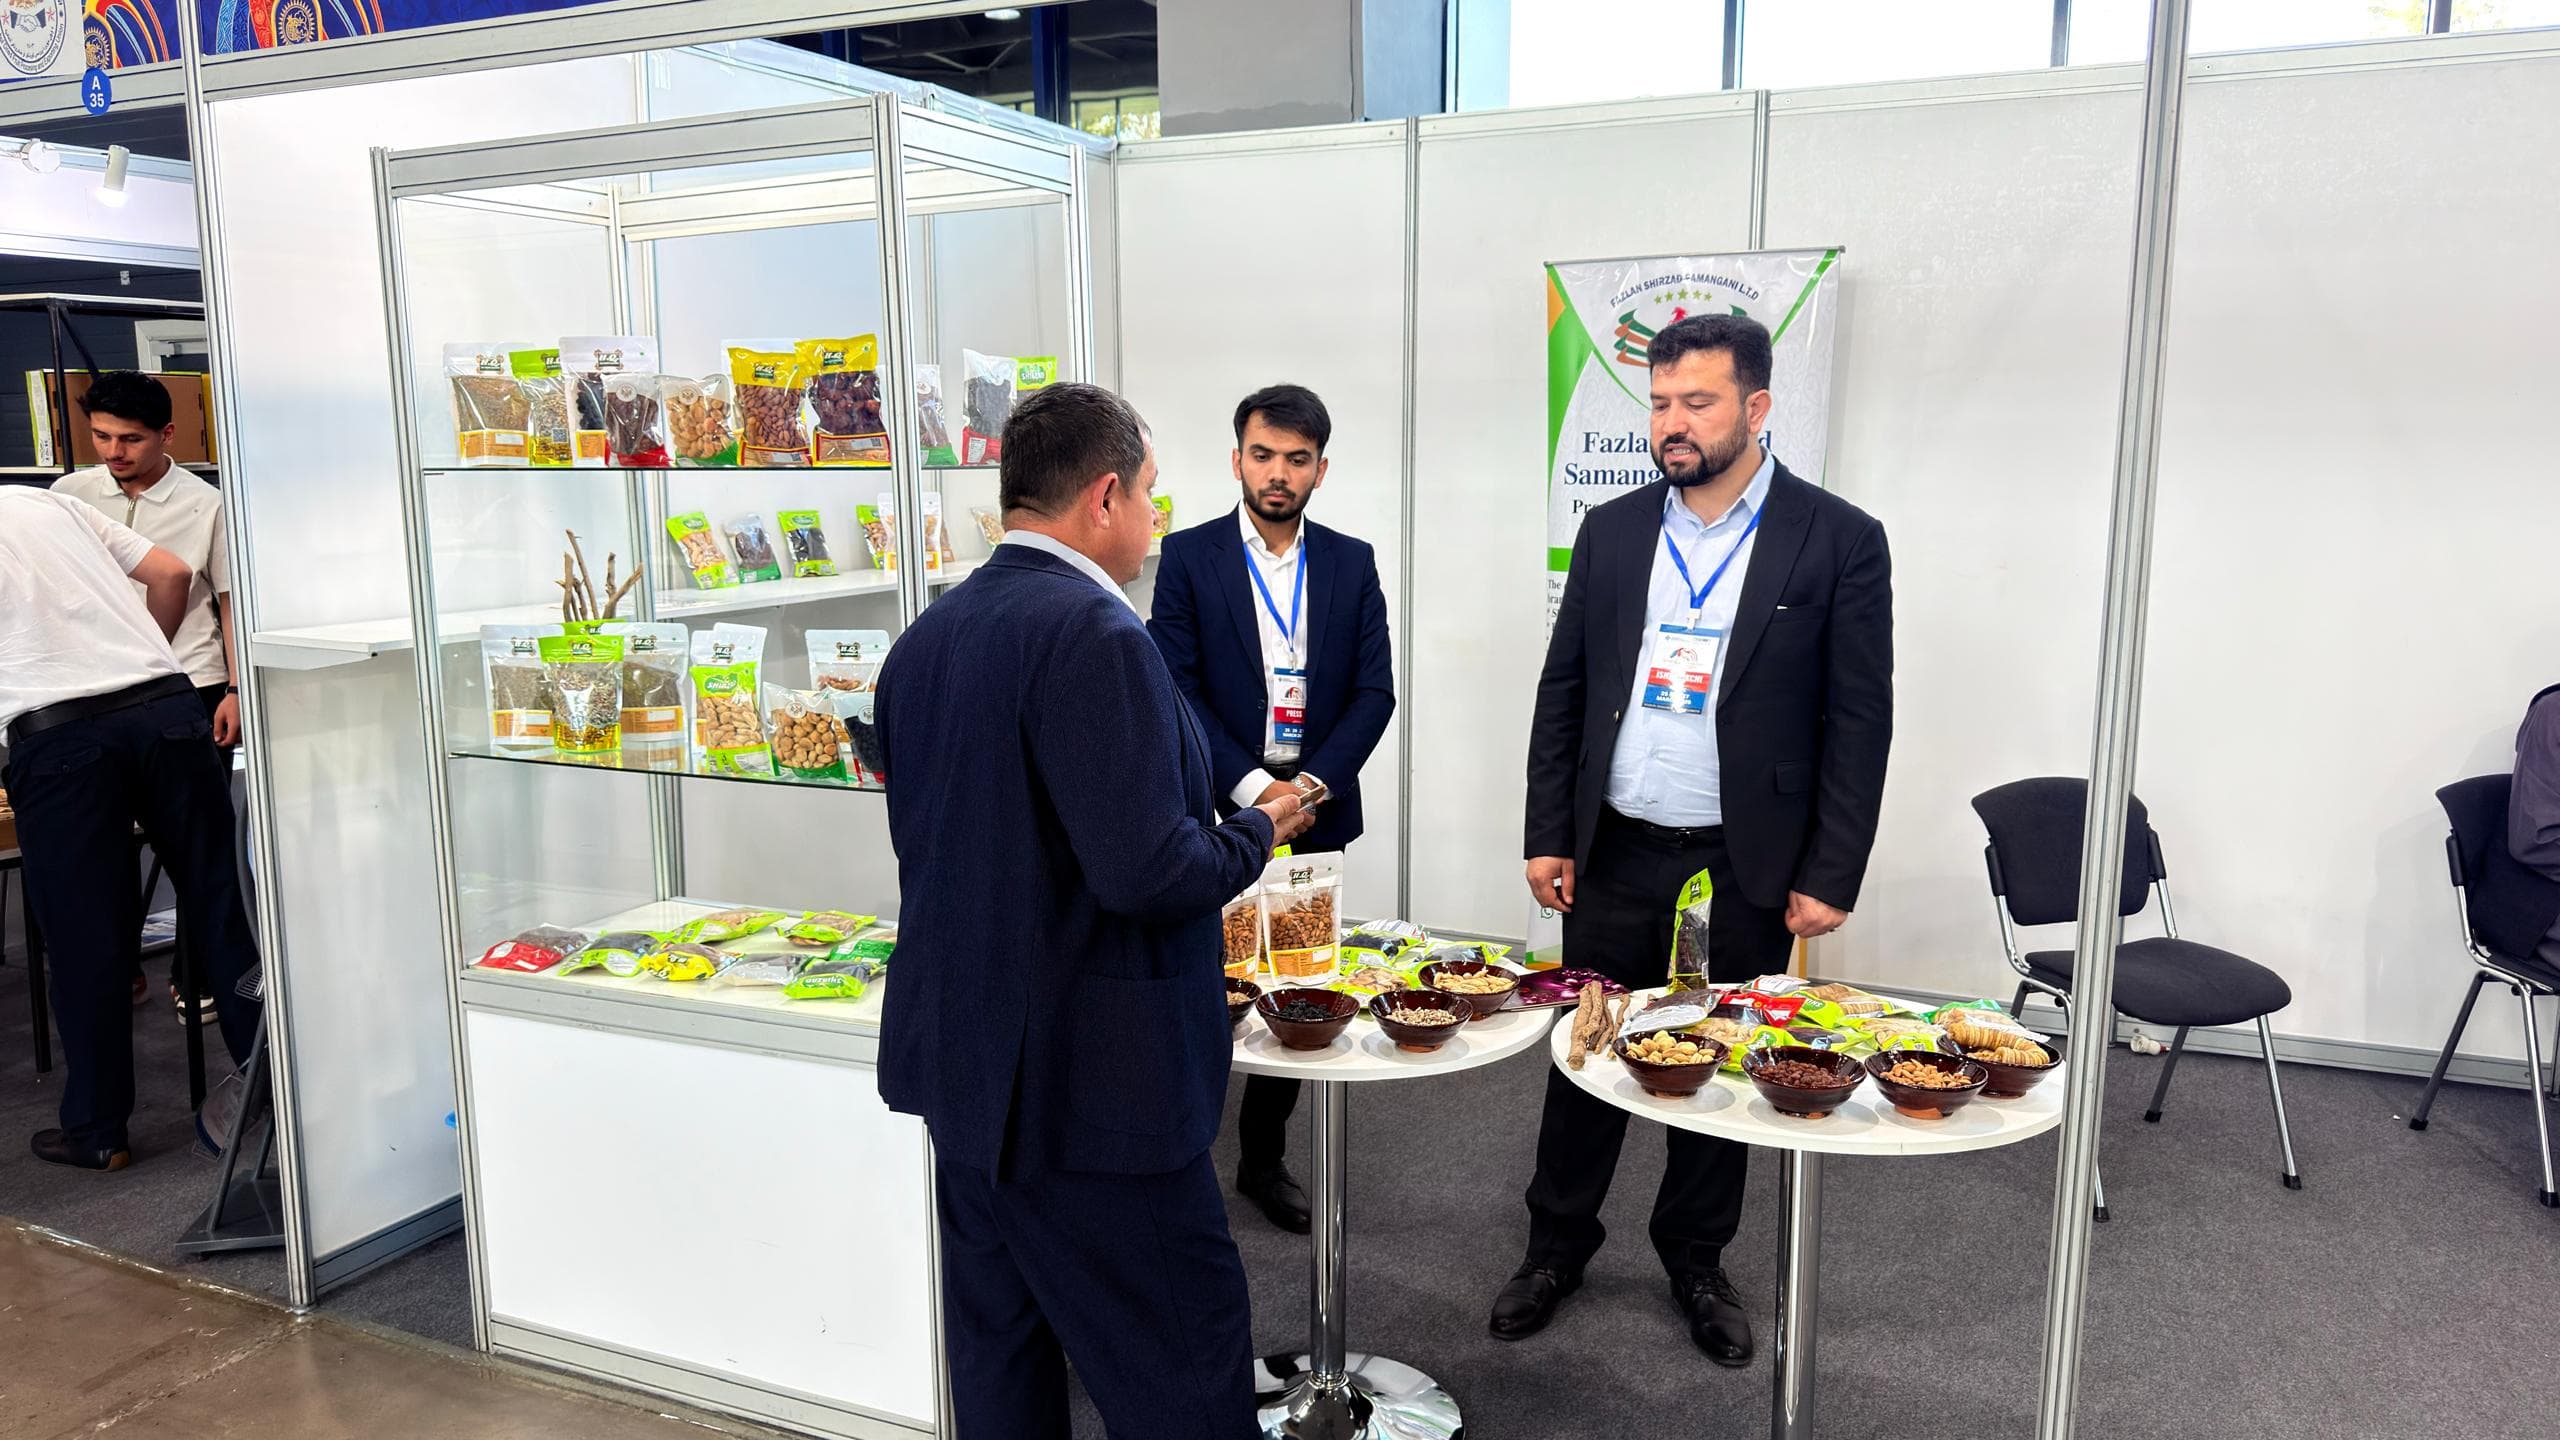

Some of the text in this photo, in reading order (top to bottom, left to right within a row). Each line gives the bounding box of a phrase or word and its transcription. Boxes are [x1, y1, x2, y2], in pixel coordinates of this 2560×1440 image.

[92, 76, 101, 90] A
[89, 93, 105, 108] 35
[1643, 273, 1683, 291] SHIRZAD
[1583, 431, 1649, 454] Fazla
[1564, 462, 1661, 486] Samang
[1286, 710, 1303, 718] PRESS
